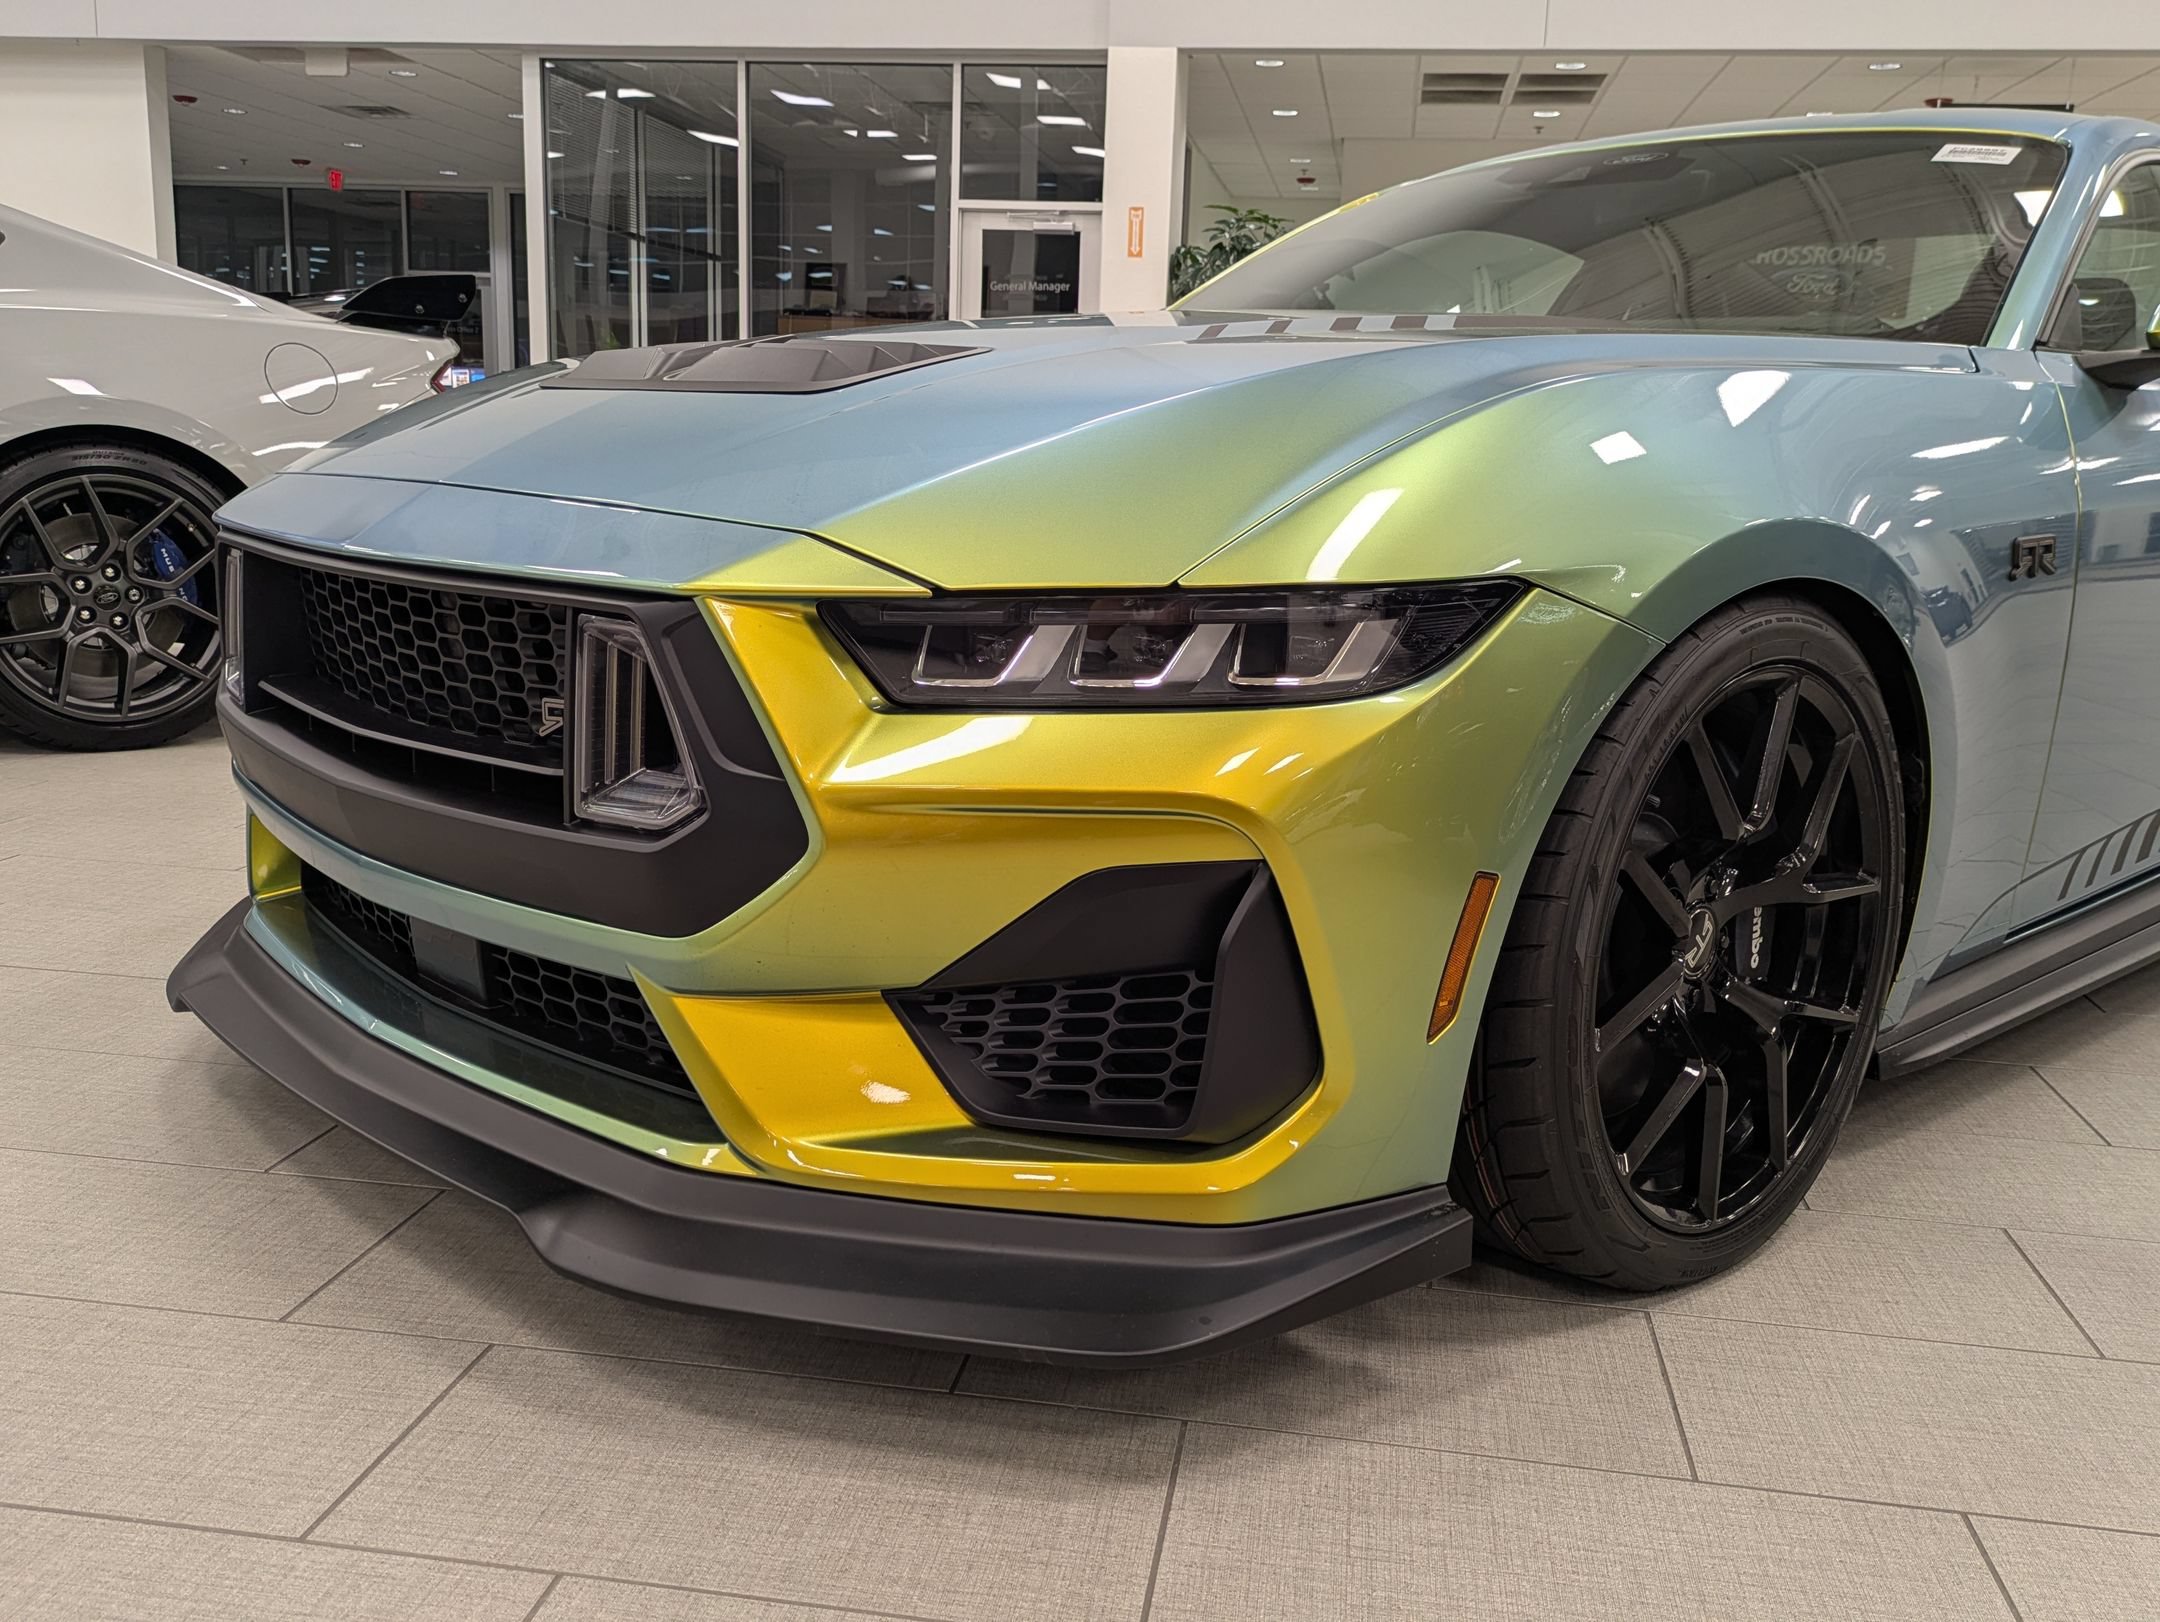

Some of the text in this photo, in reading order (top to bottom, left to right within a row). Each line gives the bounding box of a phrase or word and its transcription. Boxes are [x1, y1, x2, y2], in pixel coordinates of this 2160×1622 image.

[1752, 246, 1886, 266] ROSSROADS
[990, 281, 1071, 294] General Manager
[1751, 907, 1763, 969] embo
